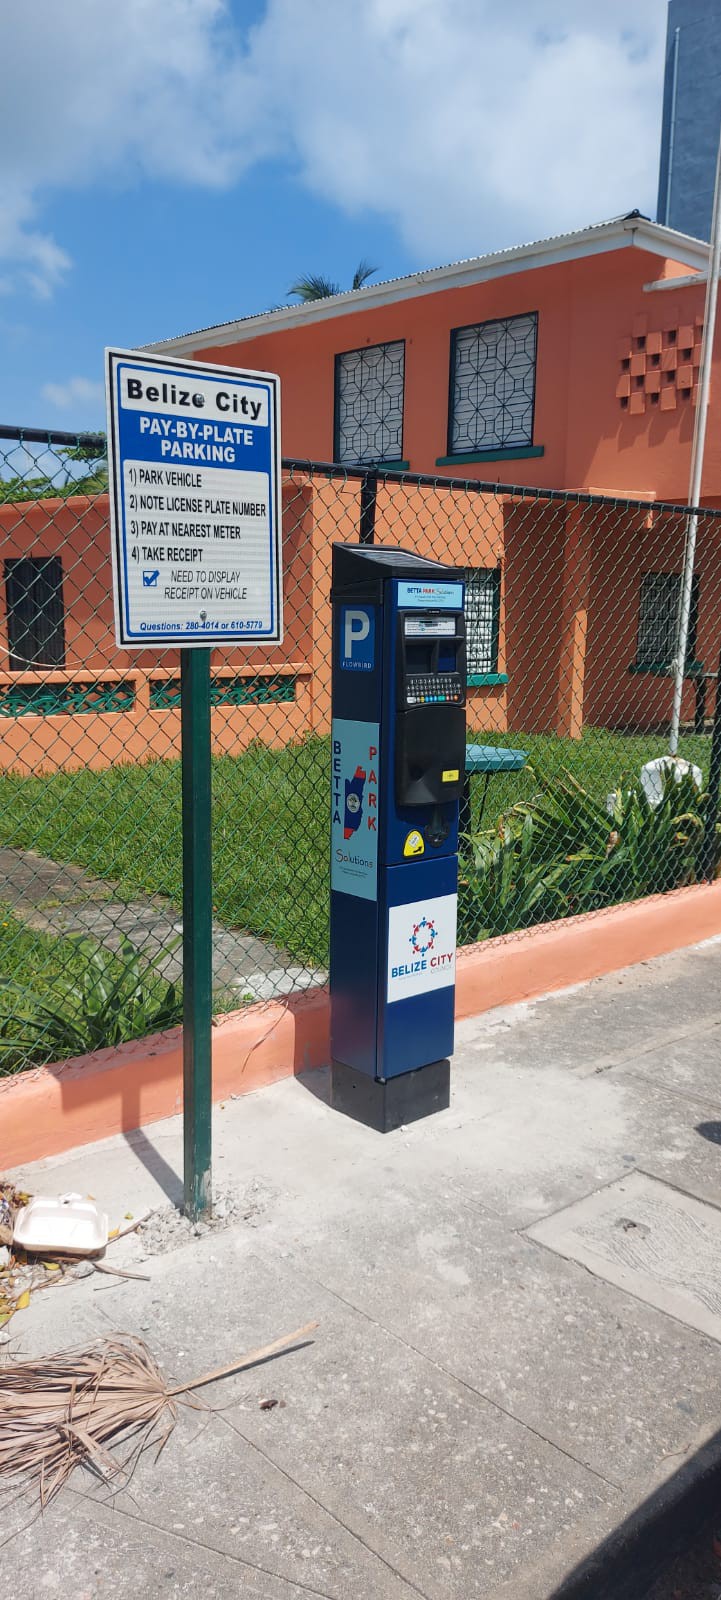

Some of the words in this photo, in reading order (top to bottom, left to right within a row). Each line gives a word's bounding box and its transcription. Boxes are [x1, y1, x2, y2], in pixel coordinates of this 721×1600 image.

[127, 378, 205, 408] Belize
[215, 391, 262, 420] City
[139, 416, 253, 446] PAY-BY-PLATE
[161, 439, 236, 463] PARKING
[129, 468, 137, 486] 1)
[139, 468, 163, 485] PARK
[165, 471, 202, 488] VEHICLE
[129, 494, 138, 512] 2)
[140, 495, 164, 511] NOTE
[166, 497, 203, 513] LICENSE
[204, 500, 231, 515] PLATE
[232, 502, 266, 517] NUMBER
[130, 520, 139, 538] 3)
[141, 521, 157, 536] PAY
[158, 522, 170, 536] AT
[171, 523, 211, 538] NEAREST
[213, 525, 241, 539] METER
[131, 546, 140, 564] 4)
[142, 546, 165, 561] TAKE
[167, 548, 203, 562] RECEIPT
[170, 570, 194, 583] NEED
[196, 570, 207, 583] TO
[208, 570, 241, 583] DISPLAY
[164, 587, 200, 600] RECEIPT
[200, 587, 214, 600] ON
[215, 587, 248, 600] VEHICLE
[139, 622, 183, 631] Questions:
[185, 621, 219, 630] 280-4014
[221, 622, 229, 630] or
[230, 620, 262, 629] 610-5779
[344, 610, 370, 658] P
[333, 740, 342, 825] BETTA
[367, 746, 378, 832] PARK
[335, 848, 373, 868] Solutions
[391, 959, 427, 978] BELIZE
[430, 952, 453, 967] CITY
